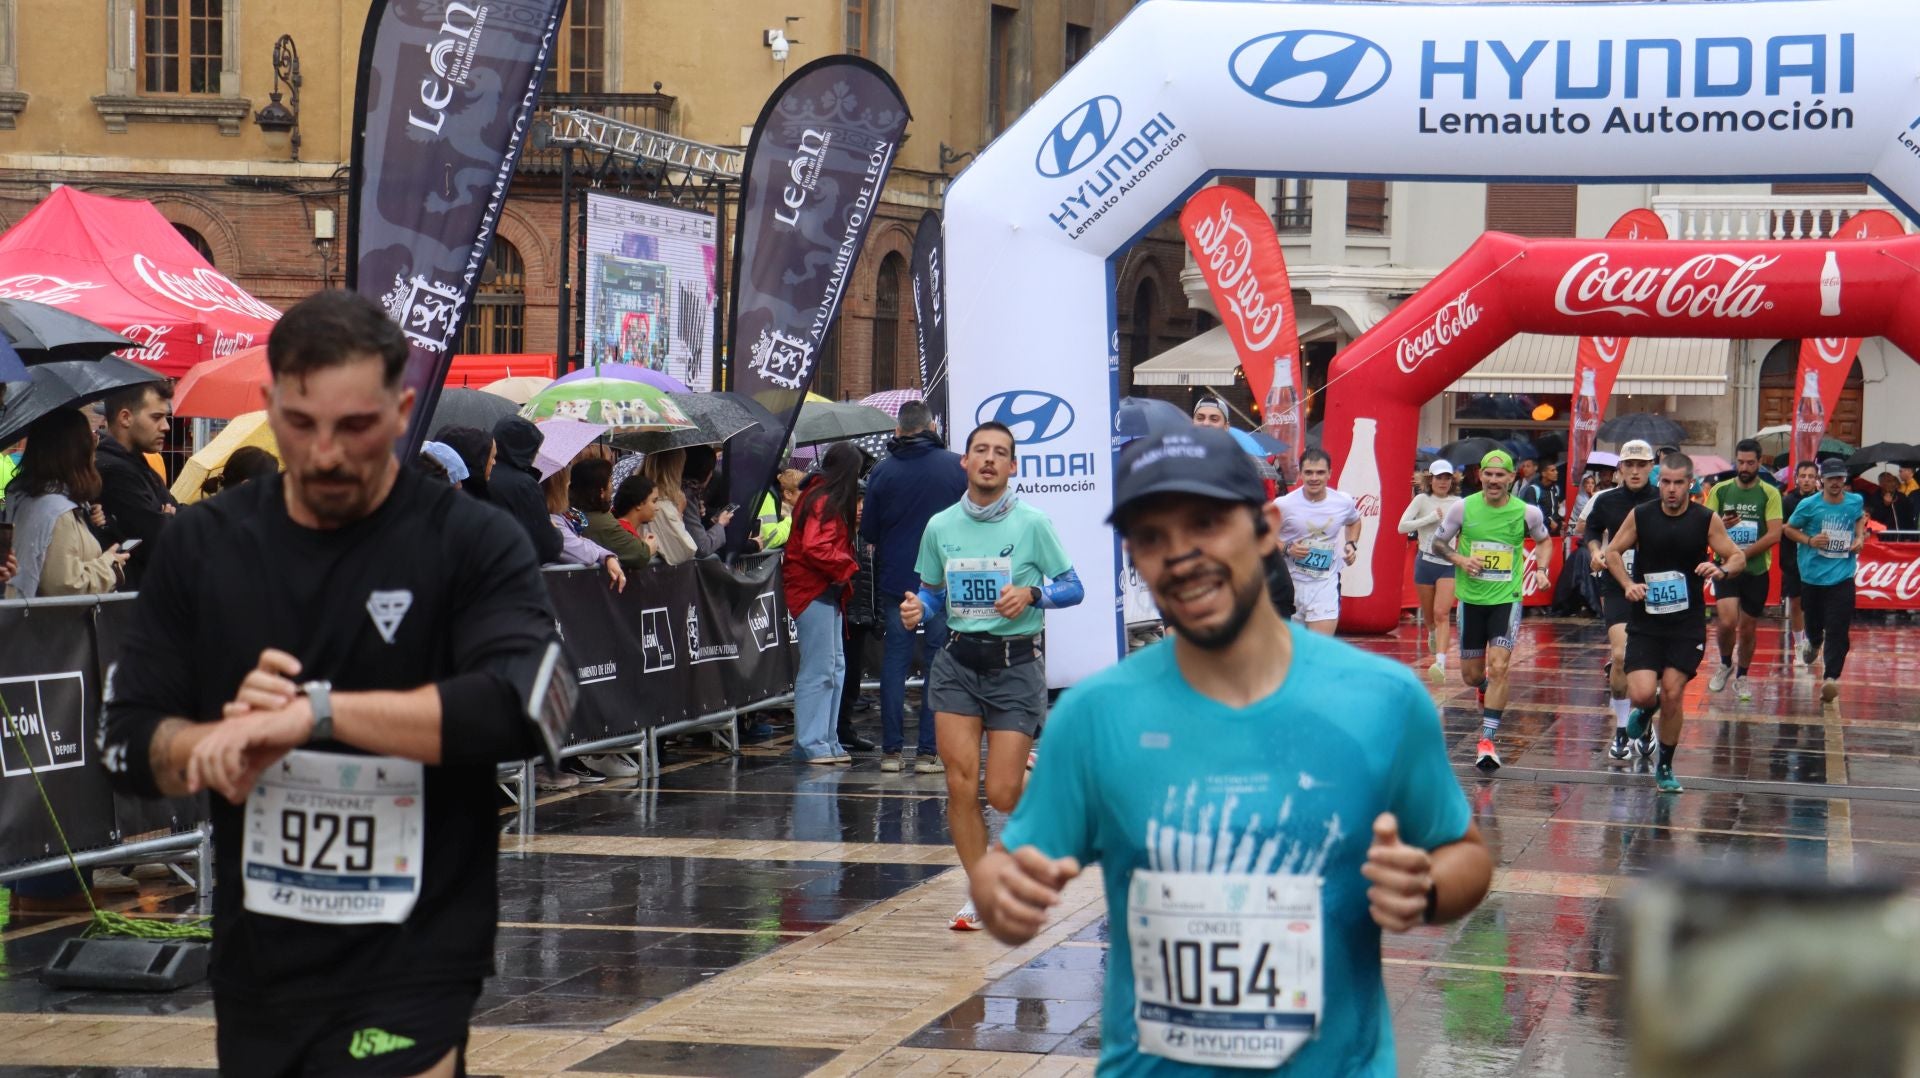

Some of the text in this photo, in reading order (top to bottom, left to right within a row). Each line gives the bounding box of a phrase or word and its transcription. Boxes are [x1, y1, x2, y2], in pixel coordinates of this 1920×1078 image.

[456, 6, 489, 85] Parlamentarismo
[447, 41, 467, 82] Cuna del
[1419, 33, 1855, 100] HYUNDAI
[1418, 99, 1855, 135] Lemauto Automoción
[808, 132, 832, 191] Parlamentarismo
[1048, 111, 1176, 231] HYUNDAI
[1068, 132, 1187, 240] Lemauto Automoción
[810, 140, 888, 341] AYUNTAMIENTO DE LEÓN
[1554, 252, 1782, 319] Coca-Cola
[1396, 287, 1482, 374] Coca-Cola
[1015, 480, 1096, 494] Automoción
[1736, 503, 1757, 513] aecc
[1731, 530, 1750, 543] 339
[1305, 552, 1328, 567] 237
[1484, 555, 1500, 570] 52
[962, 579, 997, 601] 366
[1652, 584, 1678, 602] 645
[751, 613, 769, 631] LEÓN
[644, 628, 657, 648] LEÓN
[604, 660, 617, 675] LEÓN
[2, 706, 40, 738] LEÓN
[51, 731, 61, 741] ES
[54, 743, 77, 756] DEPORTE
[281, 809, 376, 872] 929
[301, 893, 386, 911] HYUNDAI
[1159, 938, 1281, 1008] 1054
[1192, 1031, 1285, 1051] HYUNDAI
